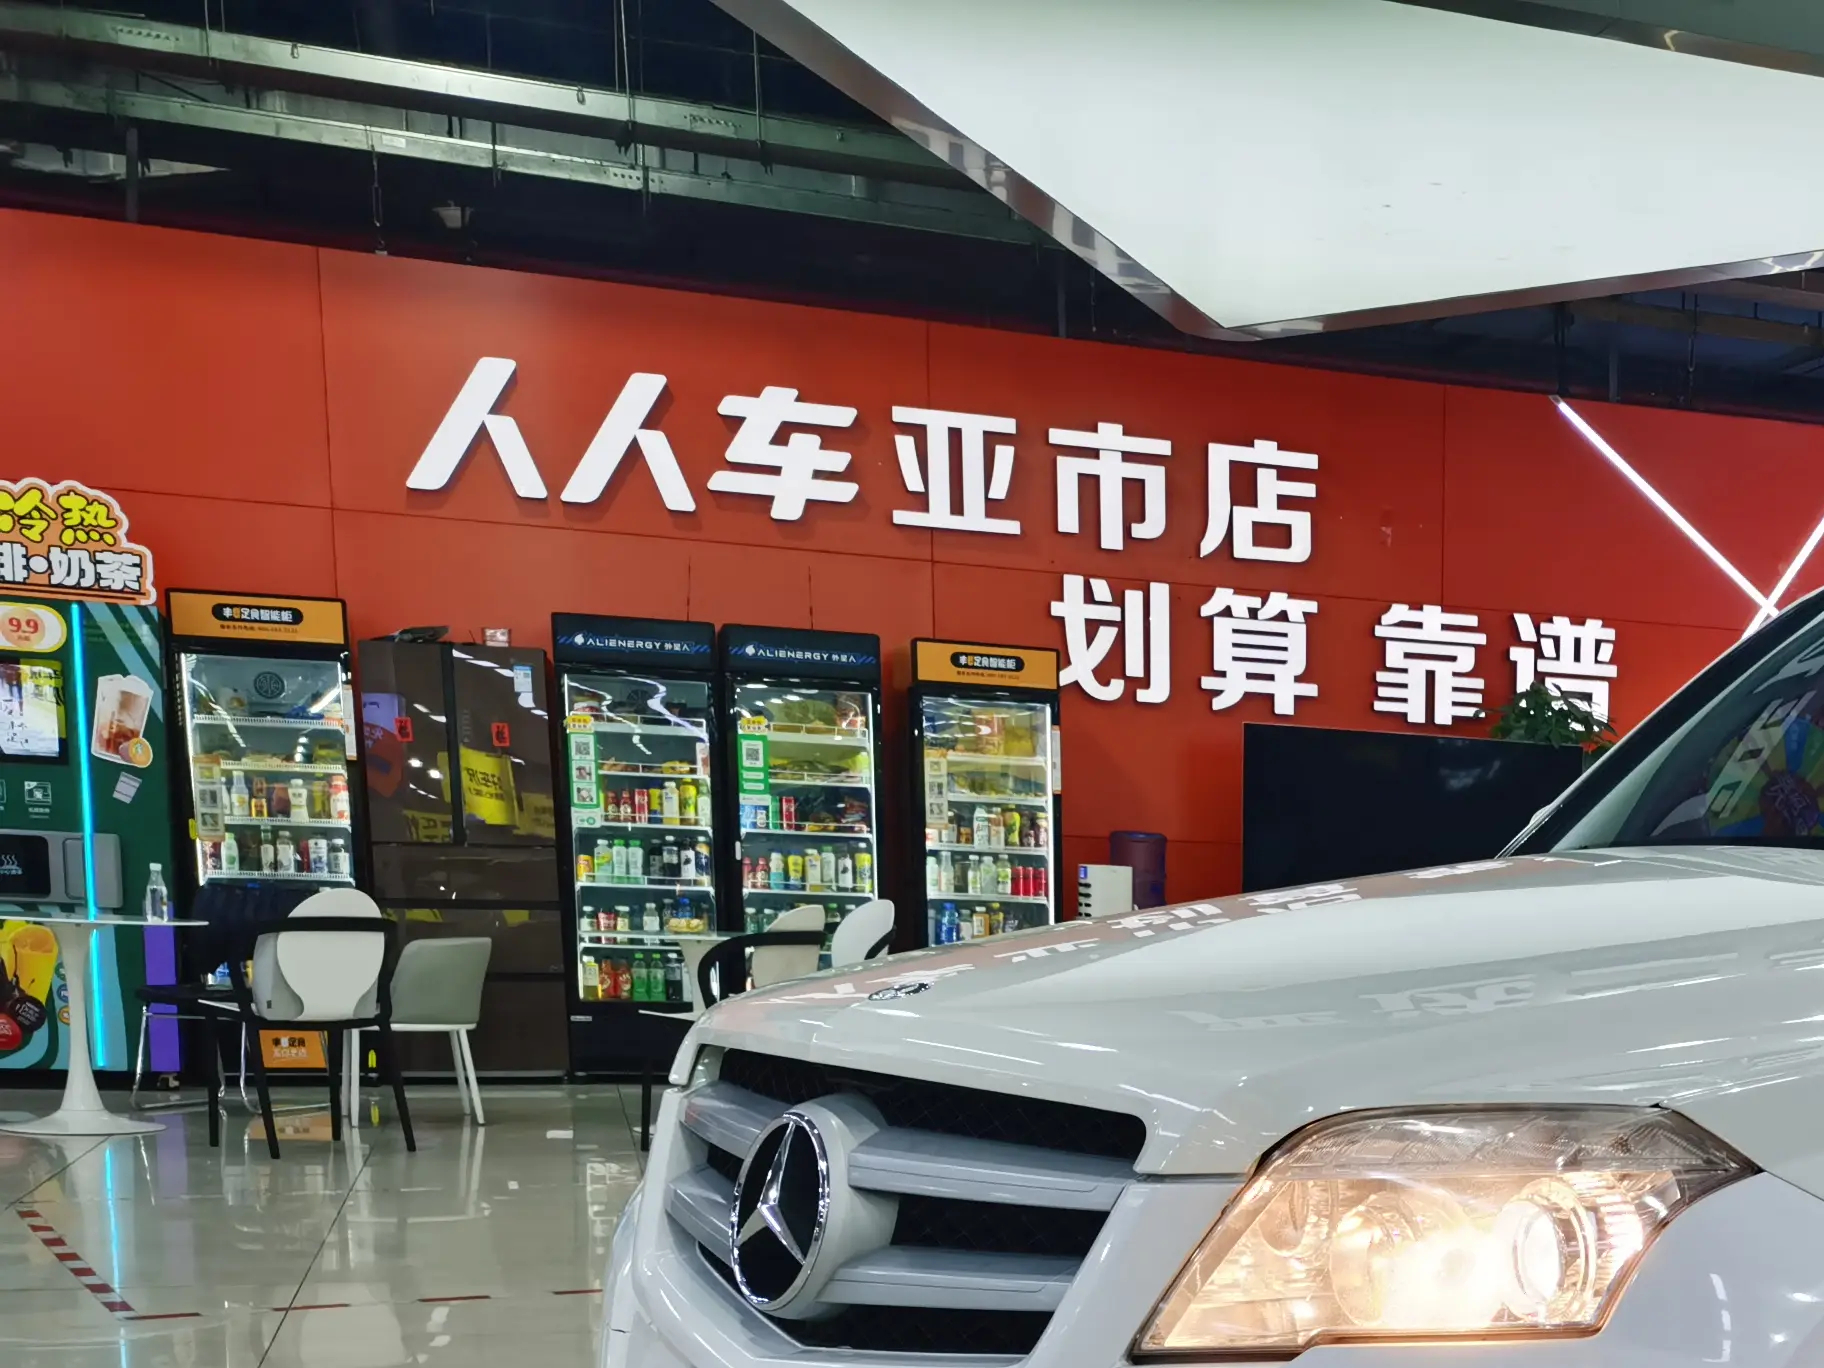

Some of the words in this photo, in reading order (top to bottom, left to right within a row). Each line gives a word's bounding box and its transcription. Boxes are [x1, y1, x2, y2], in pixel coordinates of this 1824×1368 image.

[406, 357, 1319, 562] 人人车亚市店
[8, 617, 39, 634] 9.9
[586, 638, 661, 650] ALIENERGY
[758, 649, 828, 660] ALIENERGY
